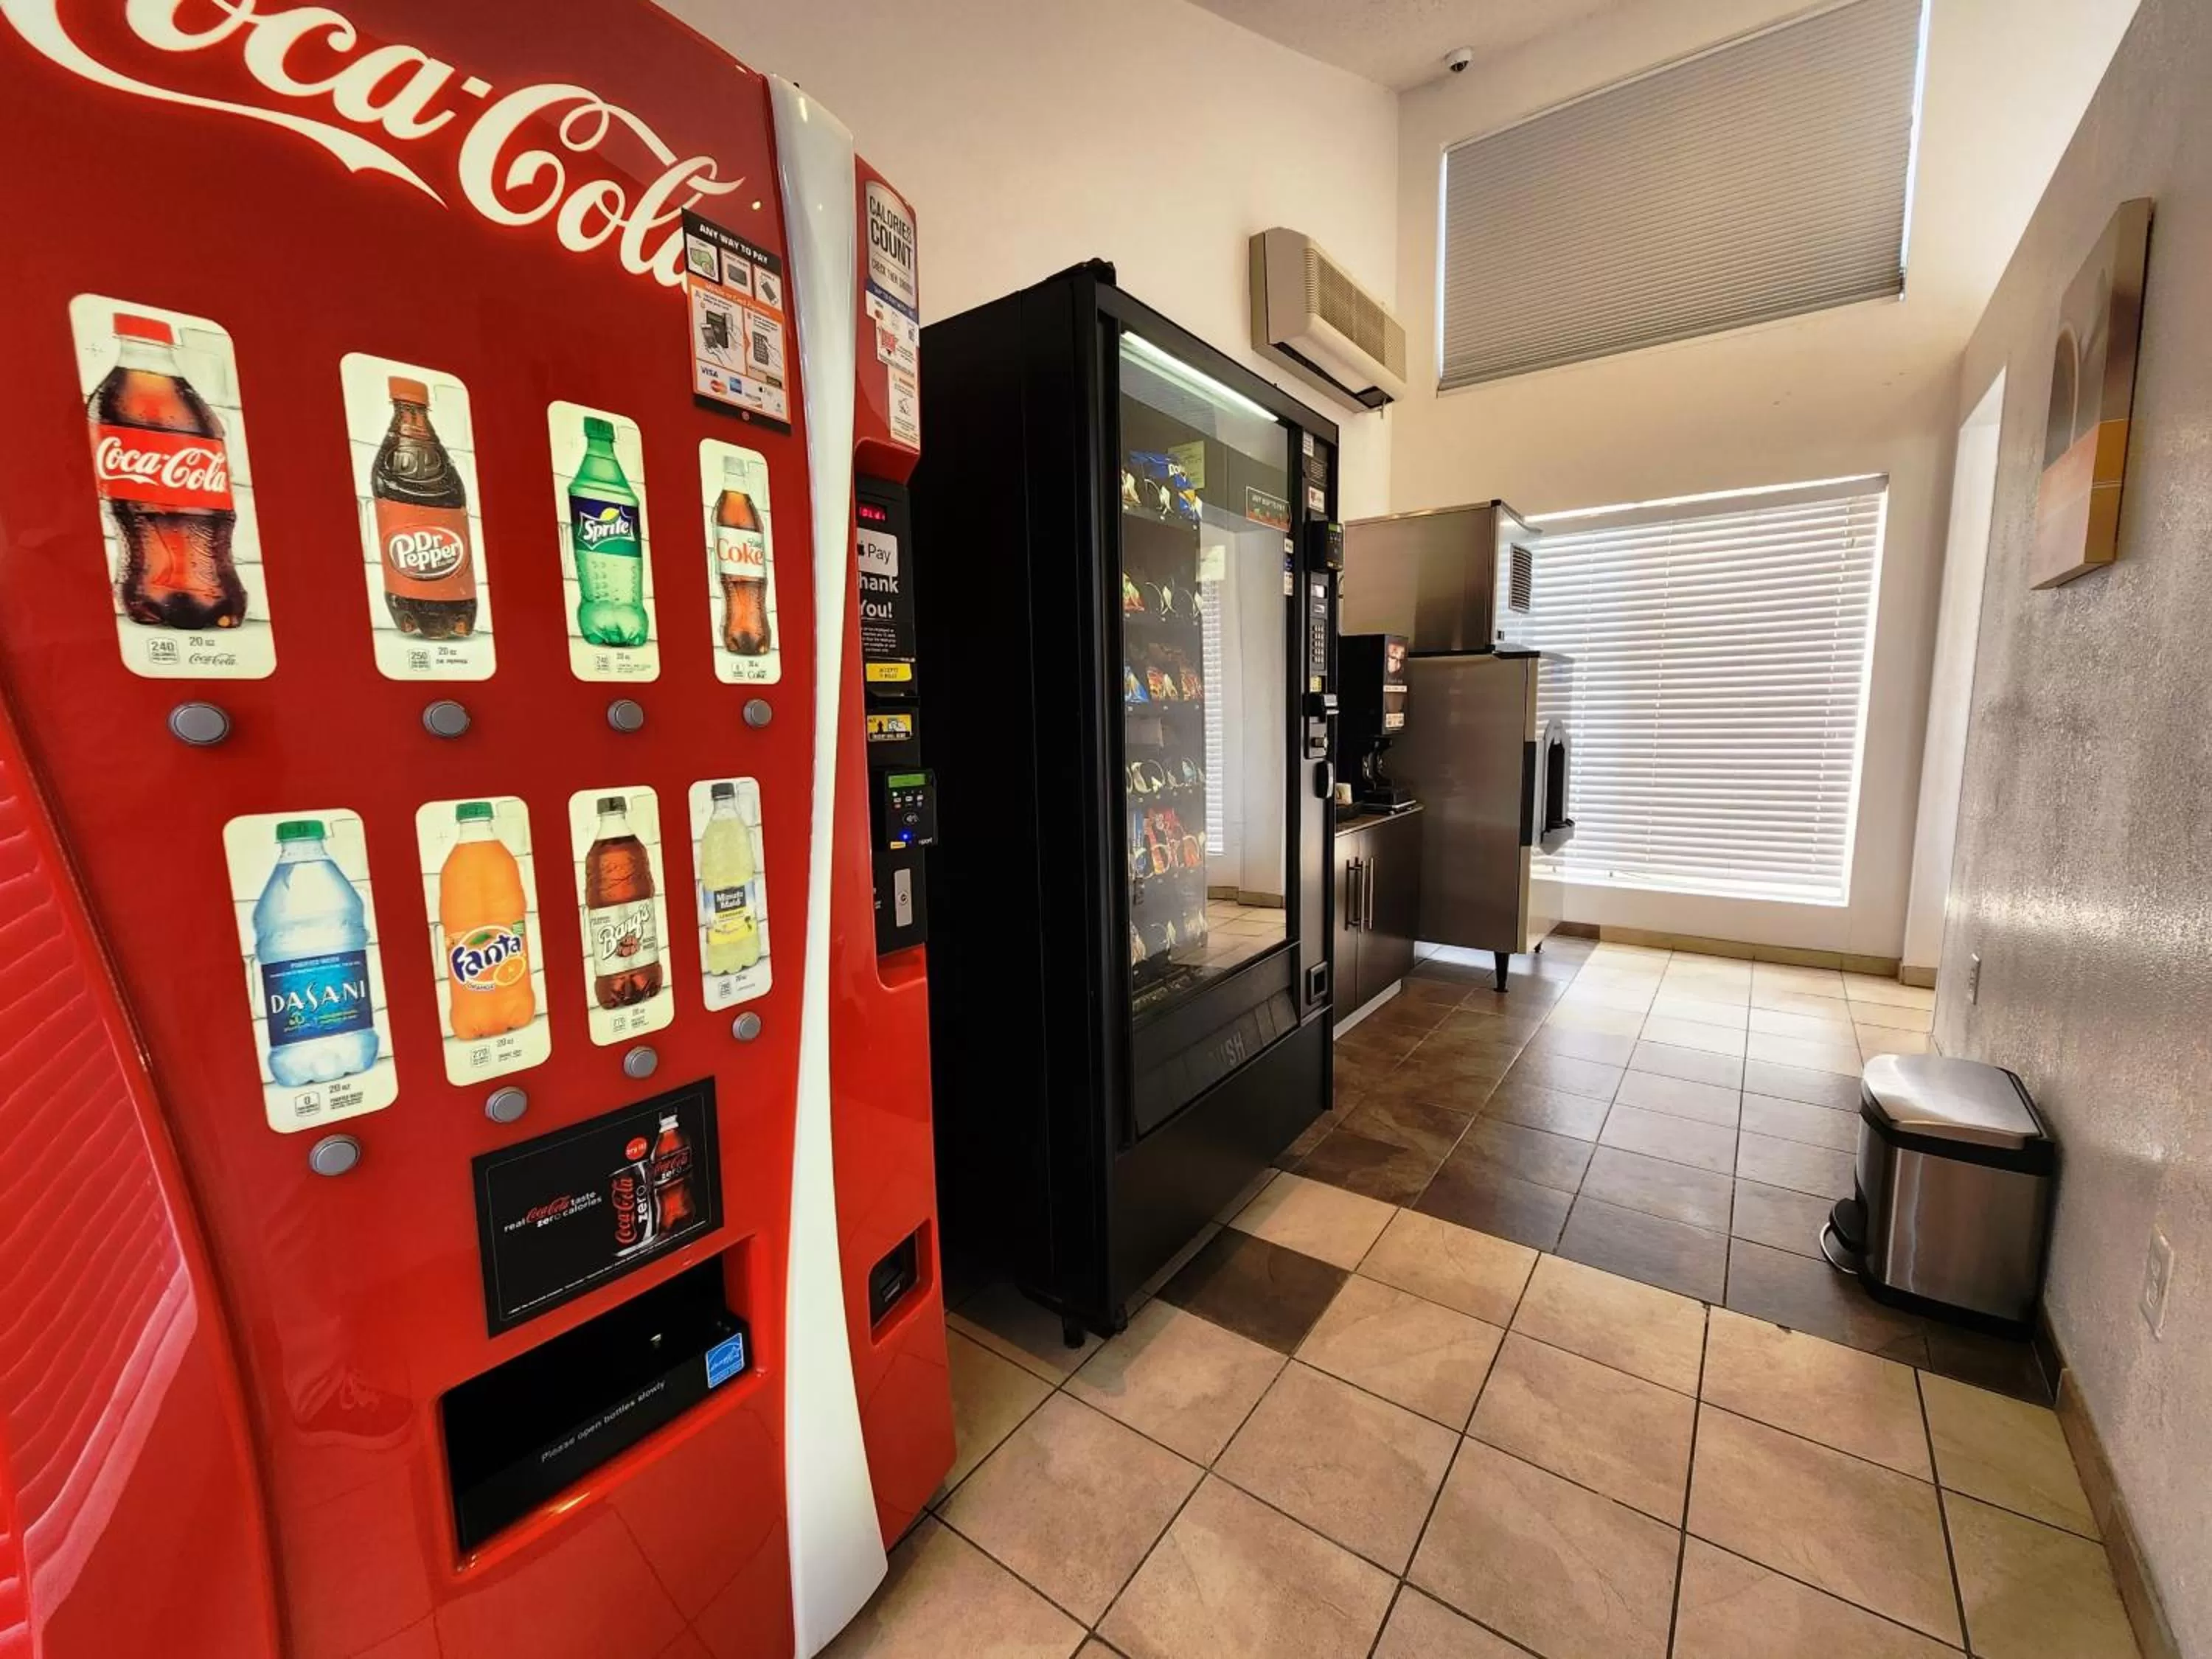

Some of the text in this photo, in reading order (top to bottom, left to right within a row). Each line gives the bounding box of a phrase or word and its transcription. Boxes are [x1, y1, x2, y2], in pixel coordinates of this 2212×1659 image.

[869, 195, 912, 245] CALORIES
[700, 223, 718, 239] ANY
[720, 234, 740, 250] WAY
[740, 243, 751, 256] TO
[753, 249, 768, 264] PAY
[871, 218, 911, 271] COUNT
[700, 366, 718, 378] VISA
[97, 437, 226, 493] Coca-Cola
[414, 531, 443, 552] Dr
[583, 517, 629, 543] Sprite
[392, 534, 459, 571] Pepper
[717, 538, 764, 566] Coke
[868, 543, 891, 566] Pay
[859, 571, 899, 593] hank
[860, 599, 892, 619] You!
[151, 641, 175, 651] 240
[189, 636, 204, 647] 20
[411, 651, 428, 660] 250
[598, 901, 651, 960] Barq's
[451, 933, 522, 983] Fanta
[271, 980, 366, 1014] DASANI
[504, 1191, 597, 1232] real Coca-Cola taste
[537, 1196, 602, 1228] zero calories
[612, 1176, 637, 1243] Coca-Cola
[637, 1185, 648, 1224] zero
[542, 1380, 665, 1463] Please open bottles slowly
